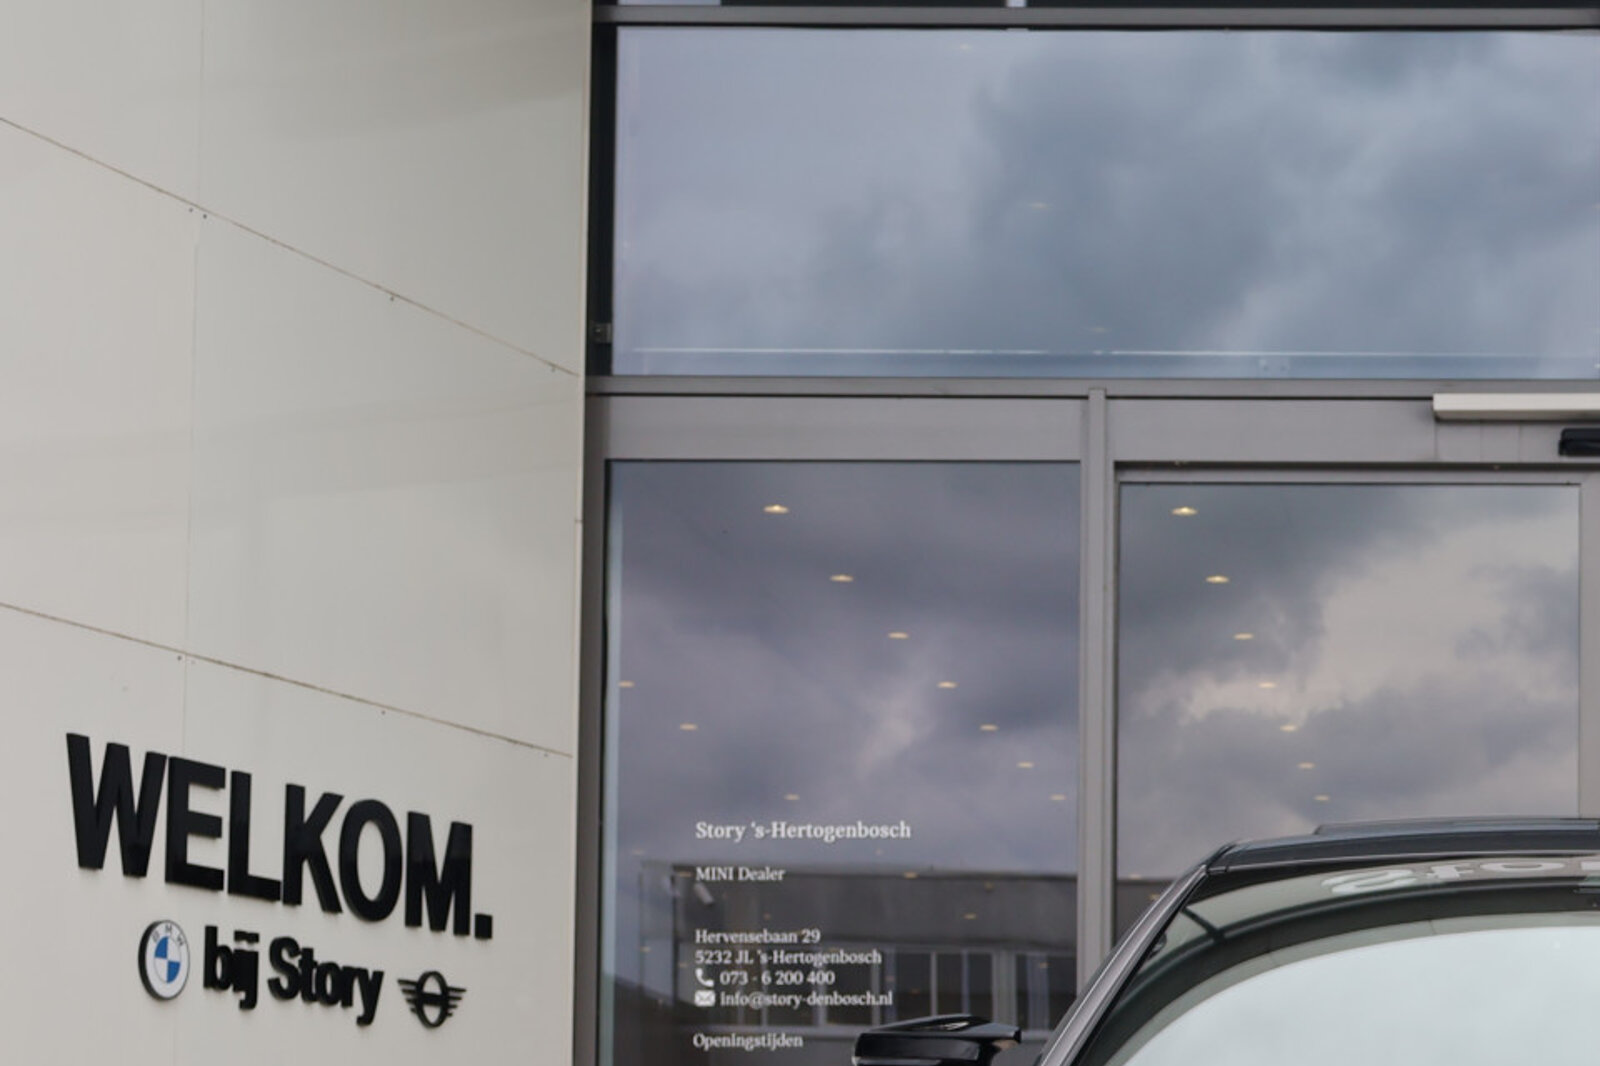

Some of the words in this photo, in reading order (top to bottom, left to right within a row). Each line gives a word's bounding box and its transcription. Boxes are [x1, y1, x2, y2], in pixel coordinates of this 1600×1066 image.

[66, 732, 493, 940] WELKOM.
[695, 821, 746, 841] Story
[751, 821, 911, 842] 's-Hertogenbosch
[696, 867, 734, 881] MINI
[737, 867, 785, 881] Dealer
[695, 930, 798, 944] Hervensebaan
[802, 929, 821, 944] 29
[695, 950, 732, 965] 5232
[735, 950, 754, 965] JL
[757, 950, 882, 967] 's-Hertogenbosch
[267, 936, 384, 1027] Story
[719, 970, 748, 986] 073
[761, 970, 772, 986] 6
[775, 970, 803, 986] 200
[807, 970, 835, 986] 400
[720, 991, 893, 1009] info@story-denbosch.nl
[693, 1033, 803, 1050] Openingstijden
